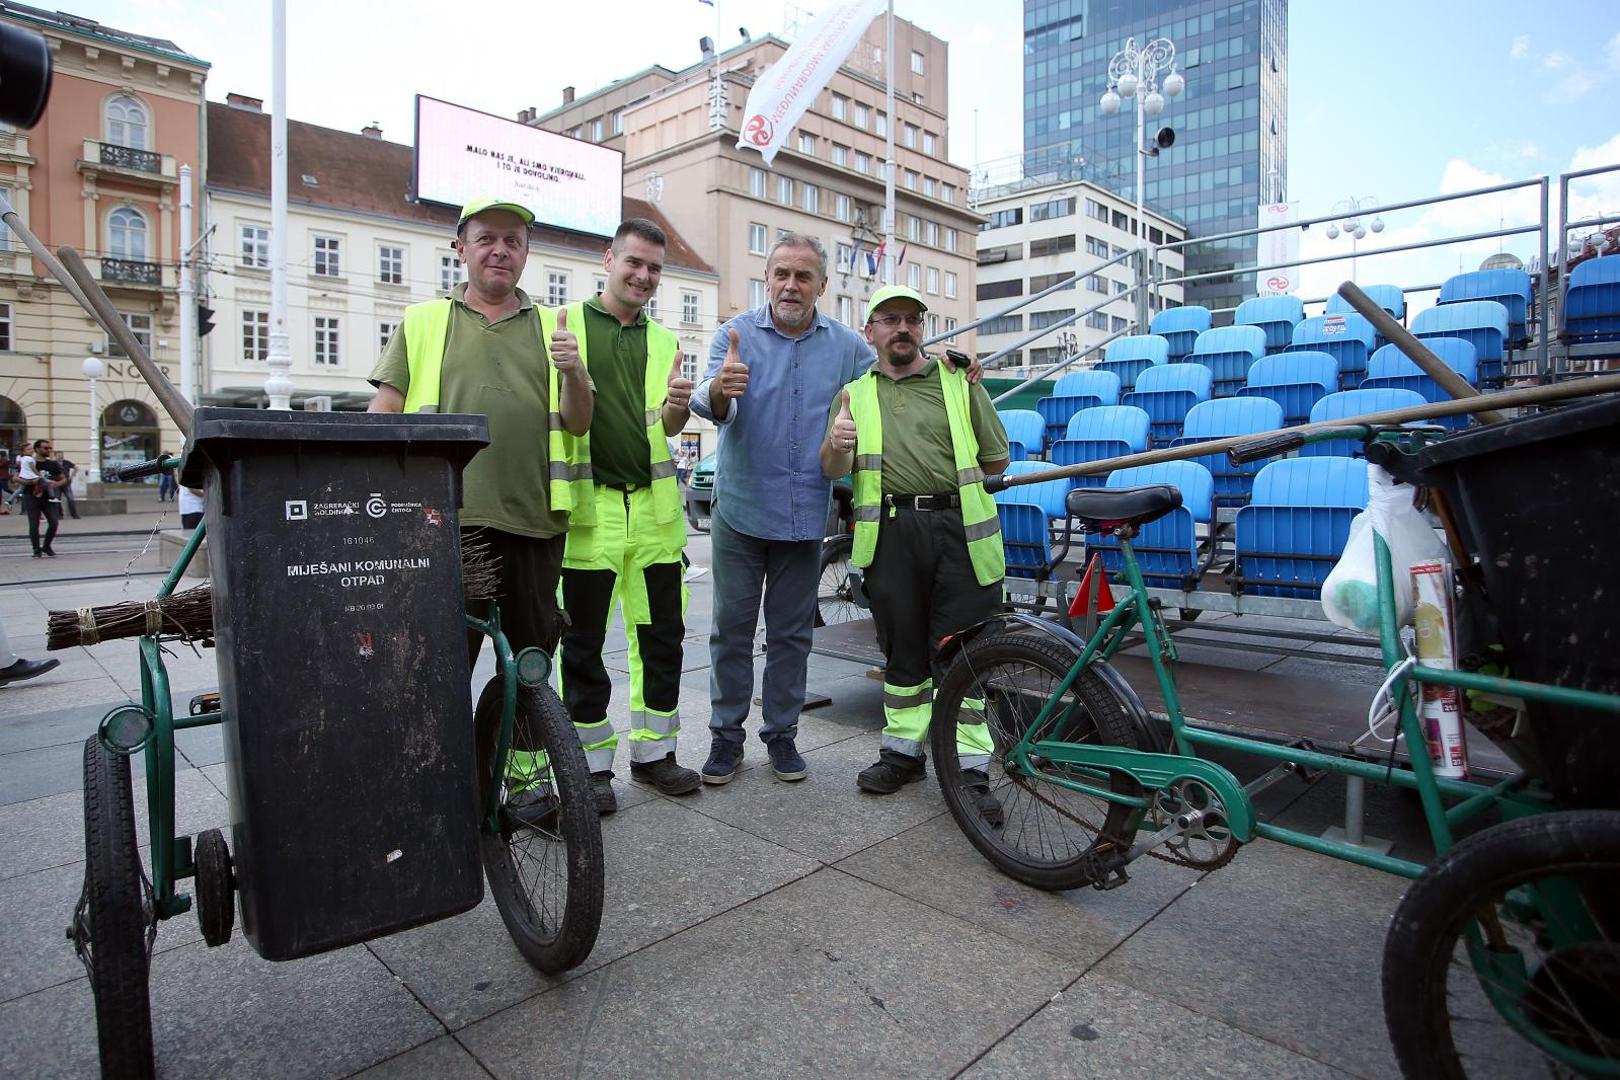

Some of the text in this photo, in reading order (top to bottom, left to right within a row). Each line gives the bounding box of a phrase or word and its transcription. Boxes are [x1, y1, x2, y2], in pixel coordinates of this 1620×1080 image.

[466, 144, 488, 156] MALO
[490, 150, 505, 160] NAS
[519, 158, 530, 167] ALI
[532, 161, 547, 171] SMO
[502, 162, 511, 171] TO
[514, 165, 521, 173] JE
[343, 536, 375, 545] 161046
[287, 557, 430, 577] MIJEŠANI KOMUNALNI
[340, 575, 385, 588] OTPAD
